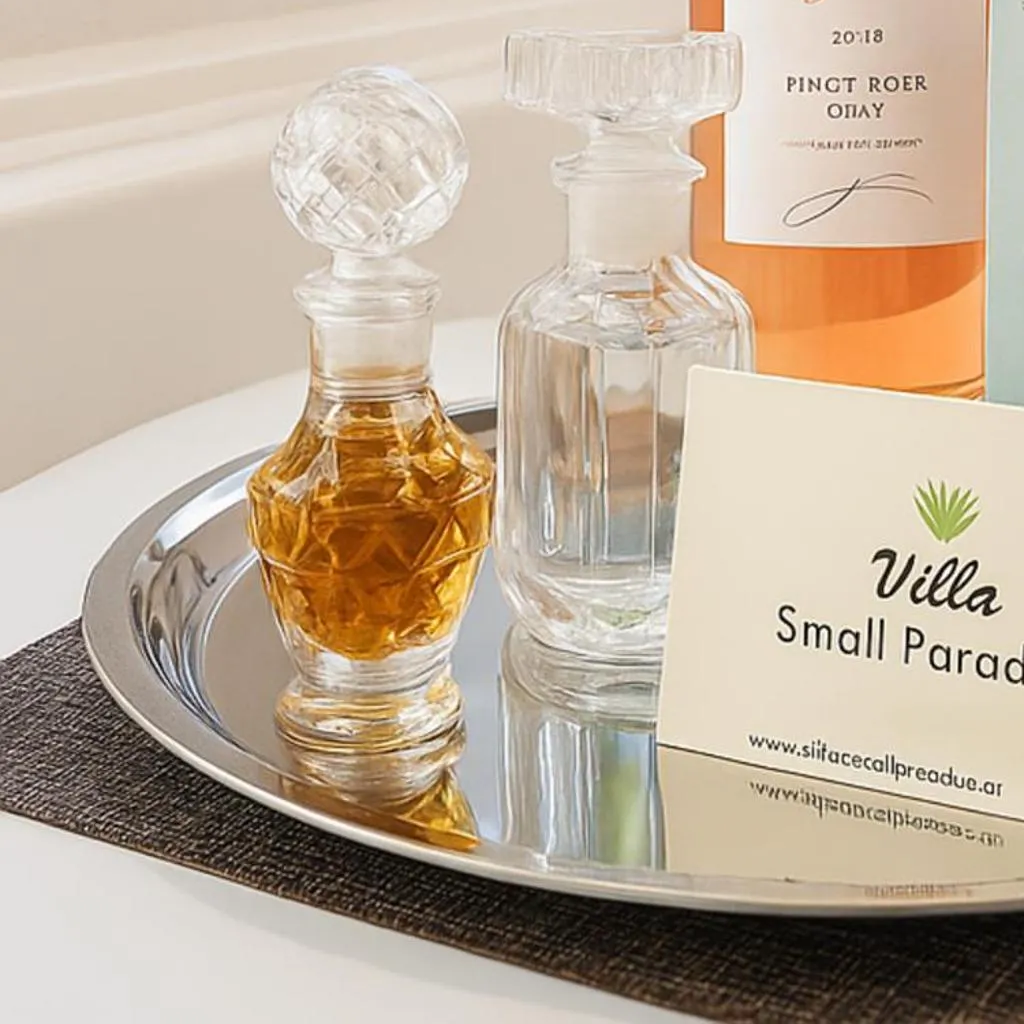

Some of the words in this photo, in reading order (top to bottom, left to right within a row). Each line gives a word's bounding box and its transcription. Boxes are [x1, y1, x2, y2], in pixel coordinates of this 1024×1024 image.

[868, 75, 928, 93] ROER
[871, 548, 1003, 617] Villa
[776, 604, 885, 660] Small
